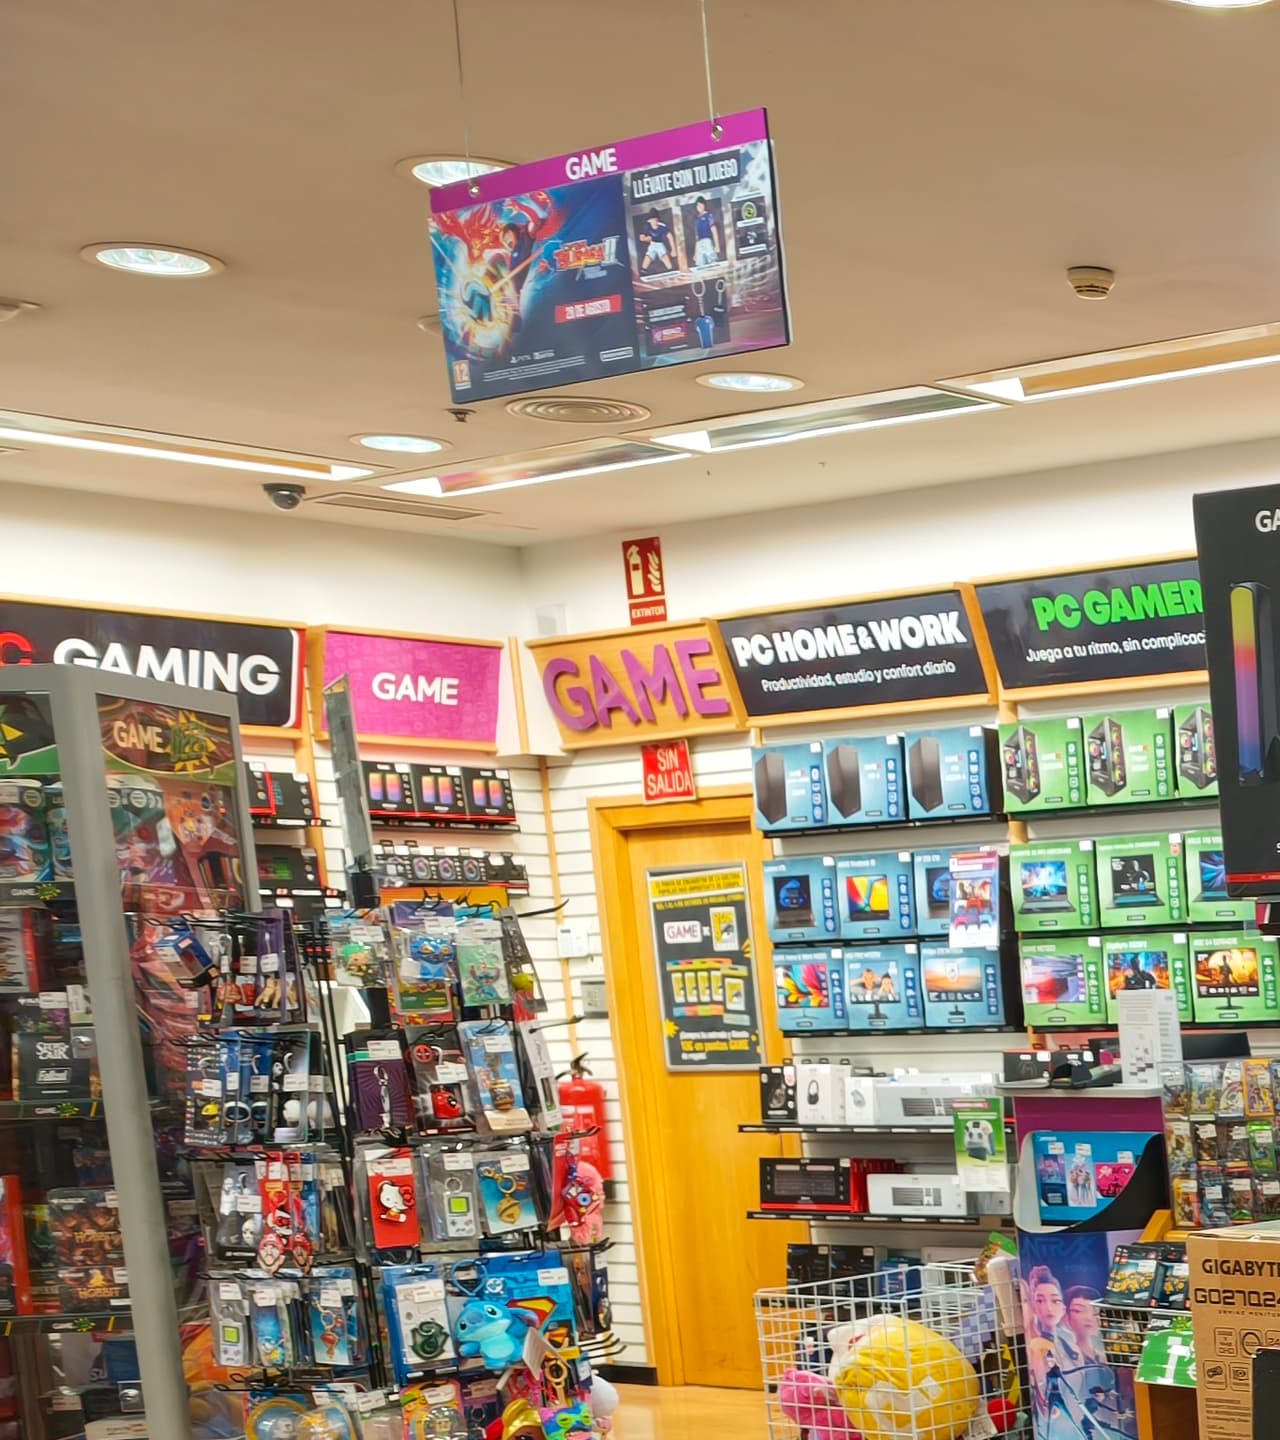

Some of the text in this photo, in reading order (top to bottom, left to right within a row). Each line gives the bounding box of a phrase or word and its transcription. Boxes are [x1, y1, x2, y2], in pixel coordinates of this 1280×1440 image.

[566, 148, 617, 180] GAME
[633, 159, 737, 198] LLÉVATE CON TU JUEGO
[631, 605, 665, 619] EXTINTOR
[1032, 597, 1080, 631] PC
[732, 635, 774, 668] PC
[1026, 630, 1206, 663] Juega a tu ritmo, sin complicac
[53, 637, 280, 695] GAMING
[762, 659, 955, 692] Productividad, estudio y confort diario
[373, 673, 459, 706] GAME
[543, 638, 730, 731] GAME
[113, 721, 164, 753] GAME
[655, 747, 680, 772] SIN
[646, 771, 694, 798] SALIDA
